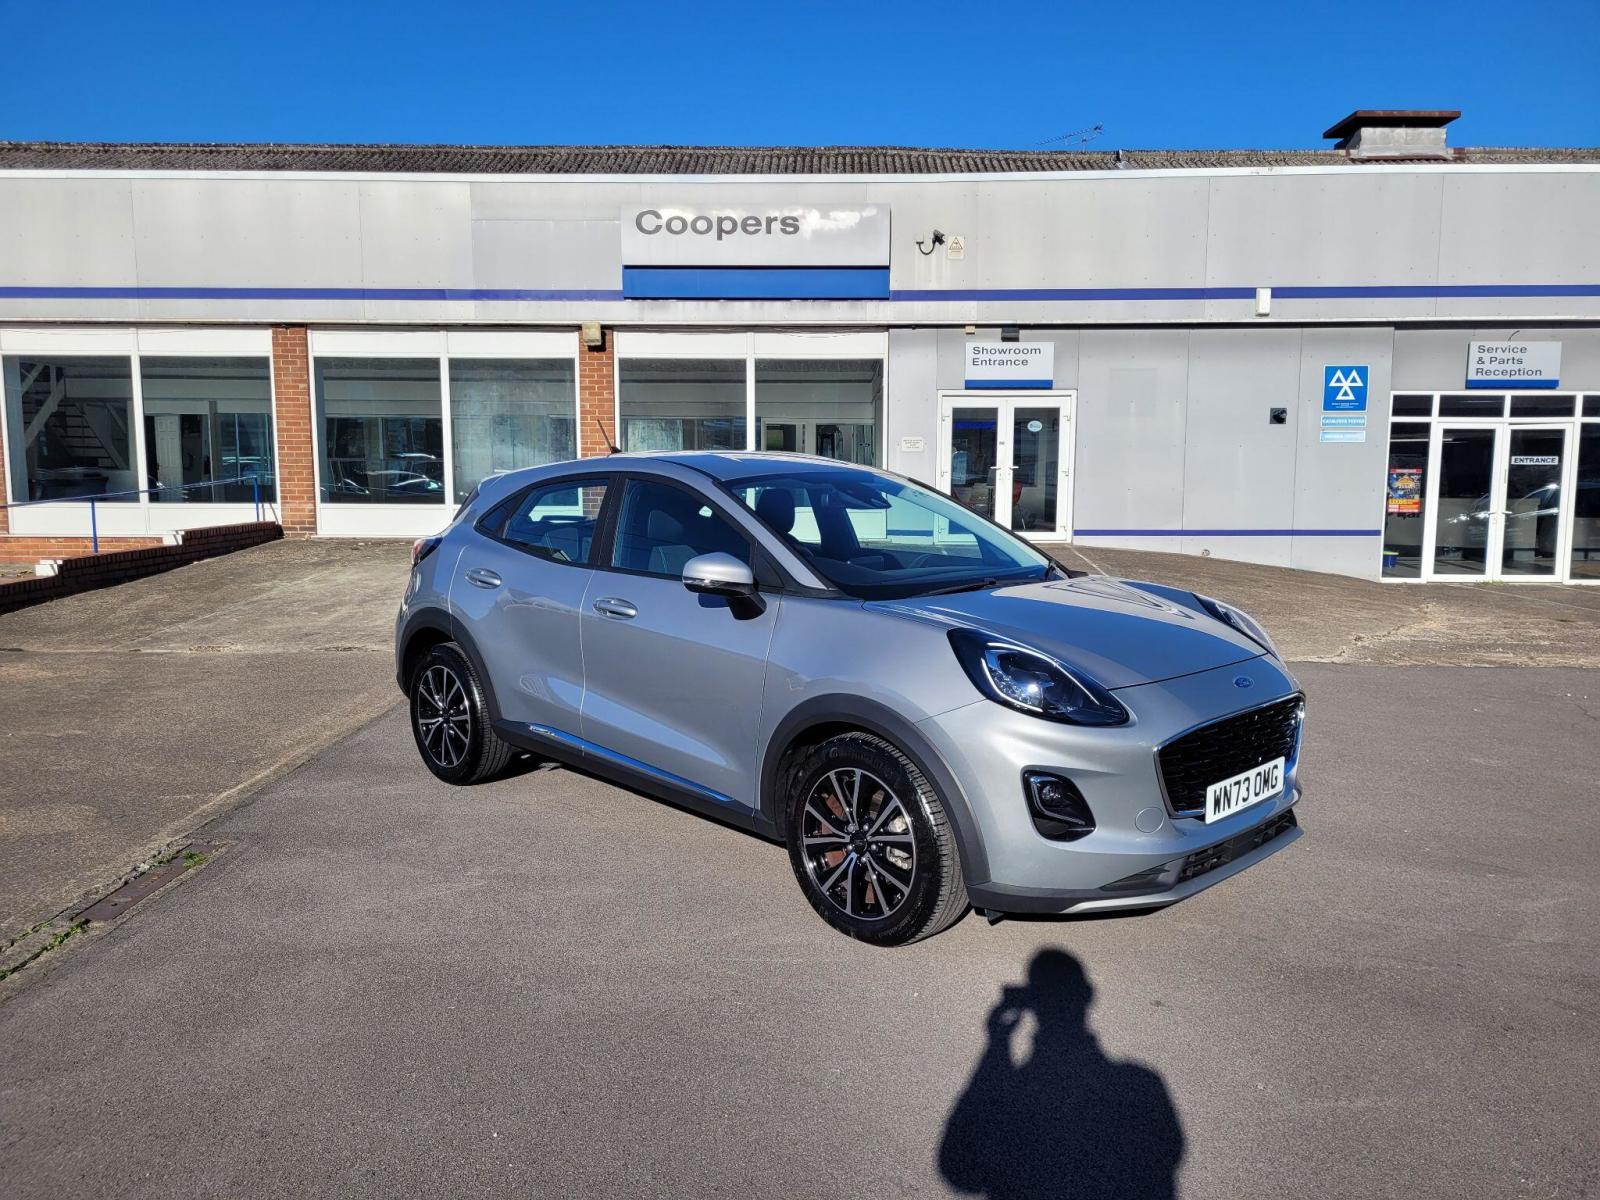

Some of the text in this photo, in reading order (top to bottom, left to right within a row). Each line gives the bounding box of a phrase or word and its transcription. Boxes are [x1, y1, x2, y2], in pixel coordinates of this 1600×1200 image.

[635, 209, 800, 241] Coopers
[972, 346, 1042, 355] Showroom
[1477, 344, 1528, 354] Service
[972, 357, 1029, 367] Entrance
[1476, 356, 1524, 365] & Parts
[1475, 367, 1543, 378] Reception
[1212, 763, 1279, 816] WN73 OMG
